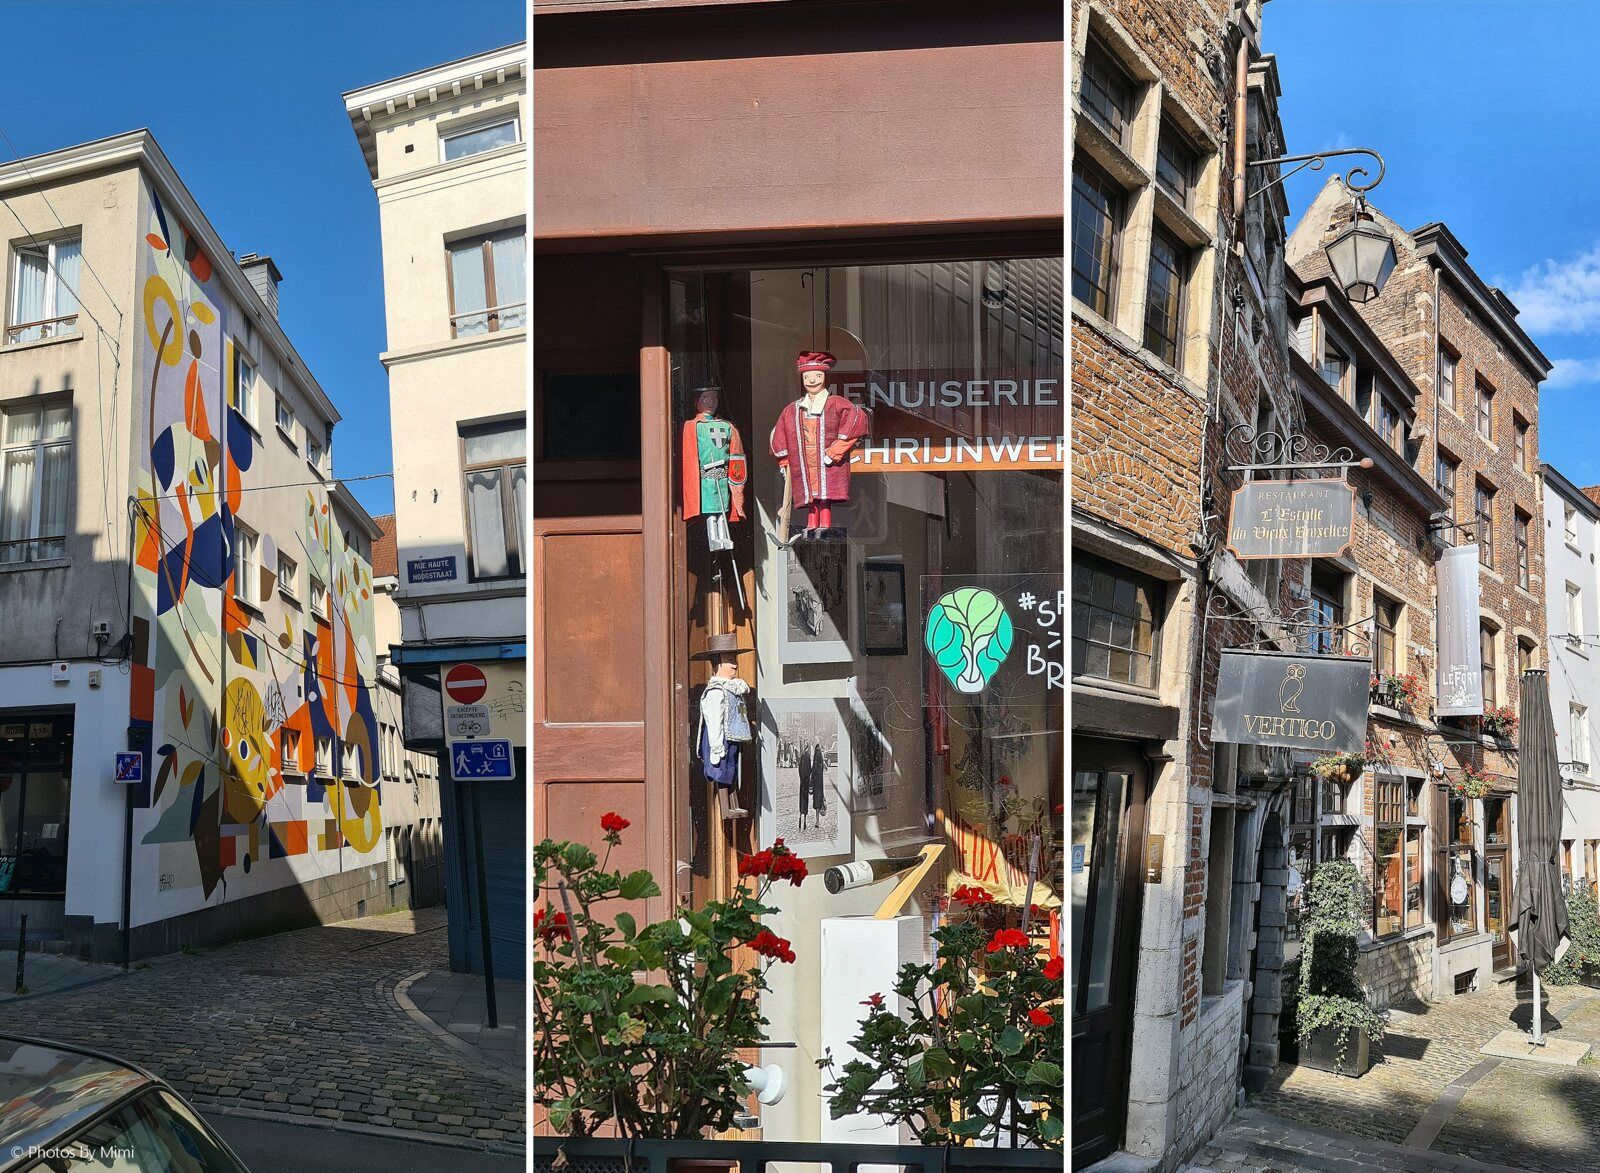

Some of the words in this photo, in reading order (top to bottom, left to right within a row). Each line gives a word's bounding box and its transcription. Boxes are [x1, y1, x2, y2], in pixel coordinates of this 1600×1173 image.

[828, 379, 1058, 408] ENUISERIE
[1258, 489, 1329, 500] RESTAURANT
[1232, 526, 1246, 540] du
[414, 562, 426, 570] RUE
[428, 560, 449, 568] HAUTE
[412, 571, 452, 580] HOOGSTRAAT
[1244, 714, 1336, 740] VERTIGO
